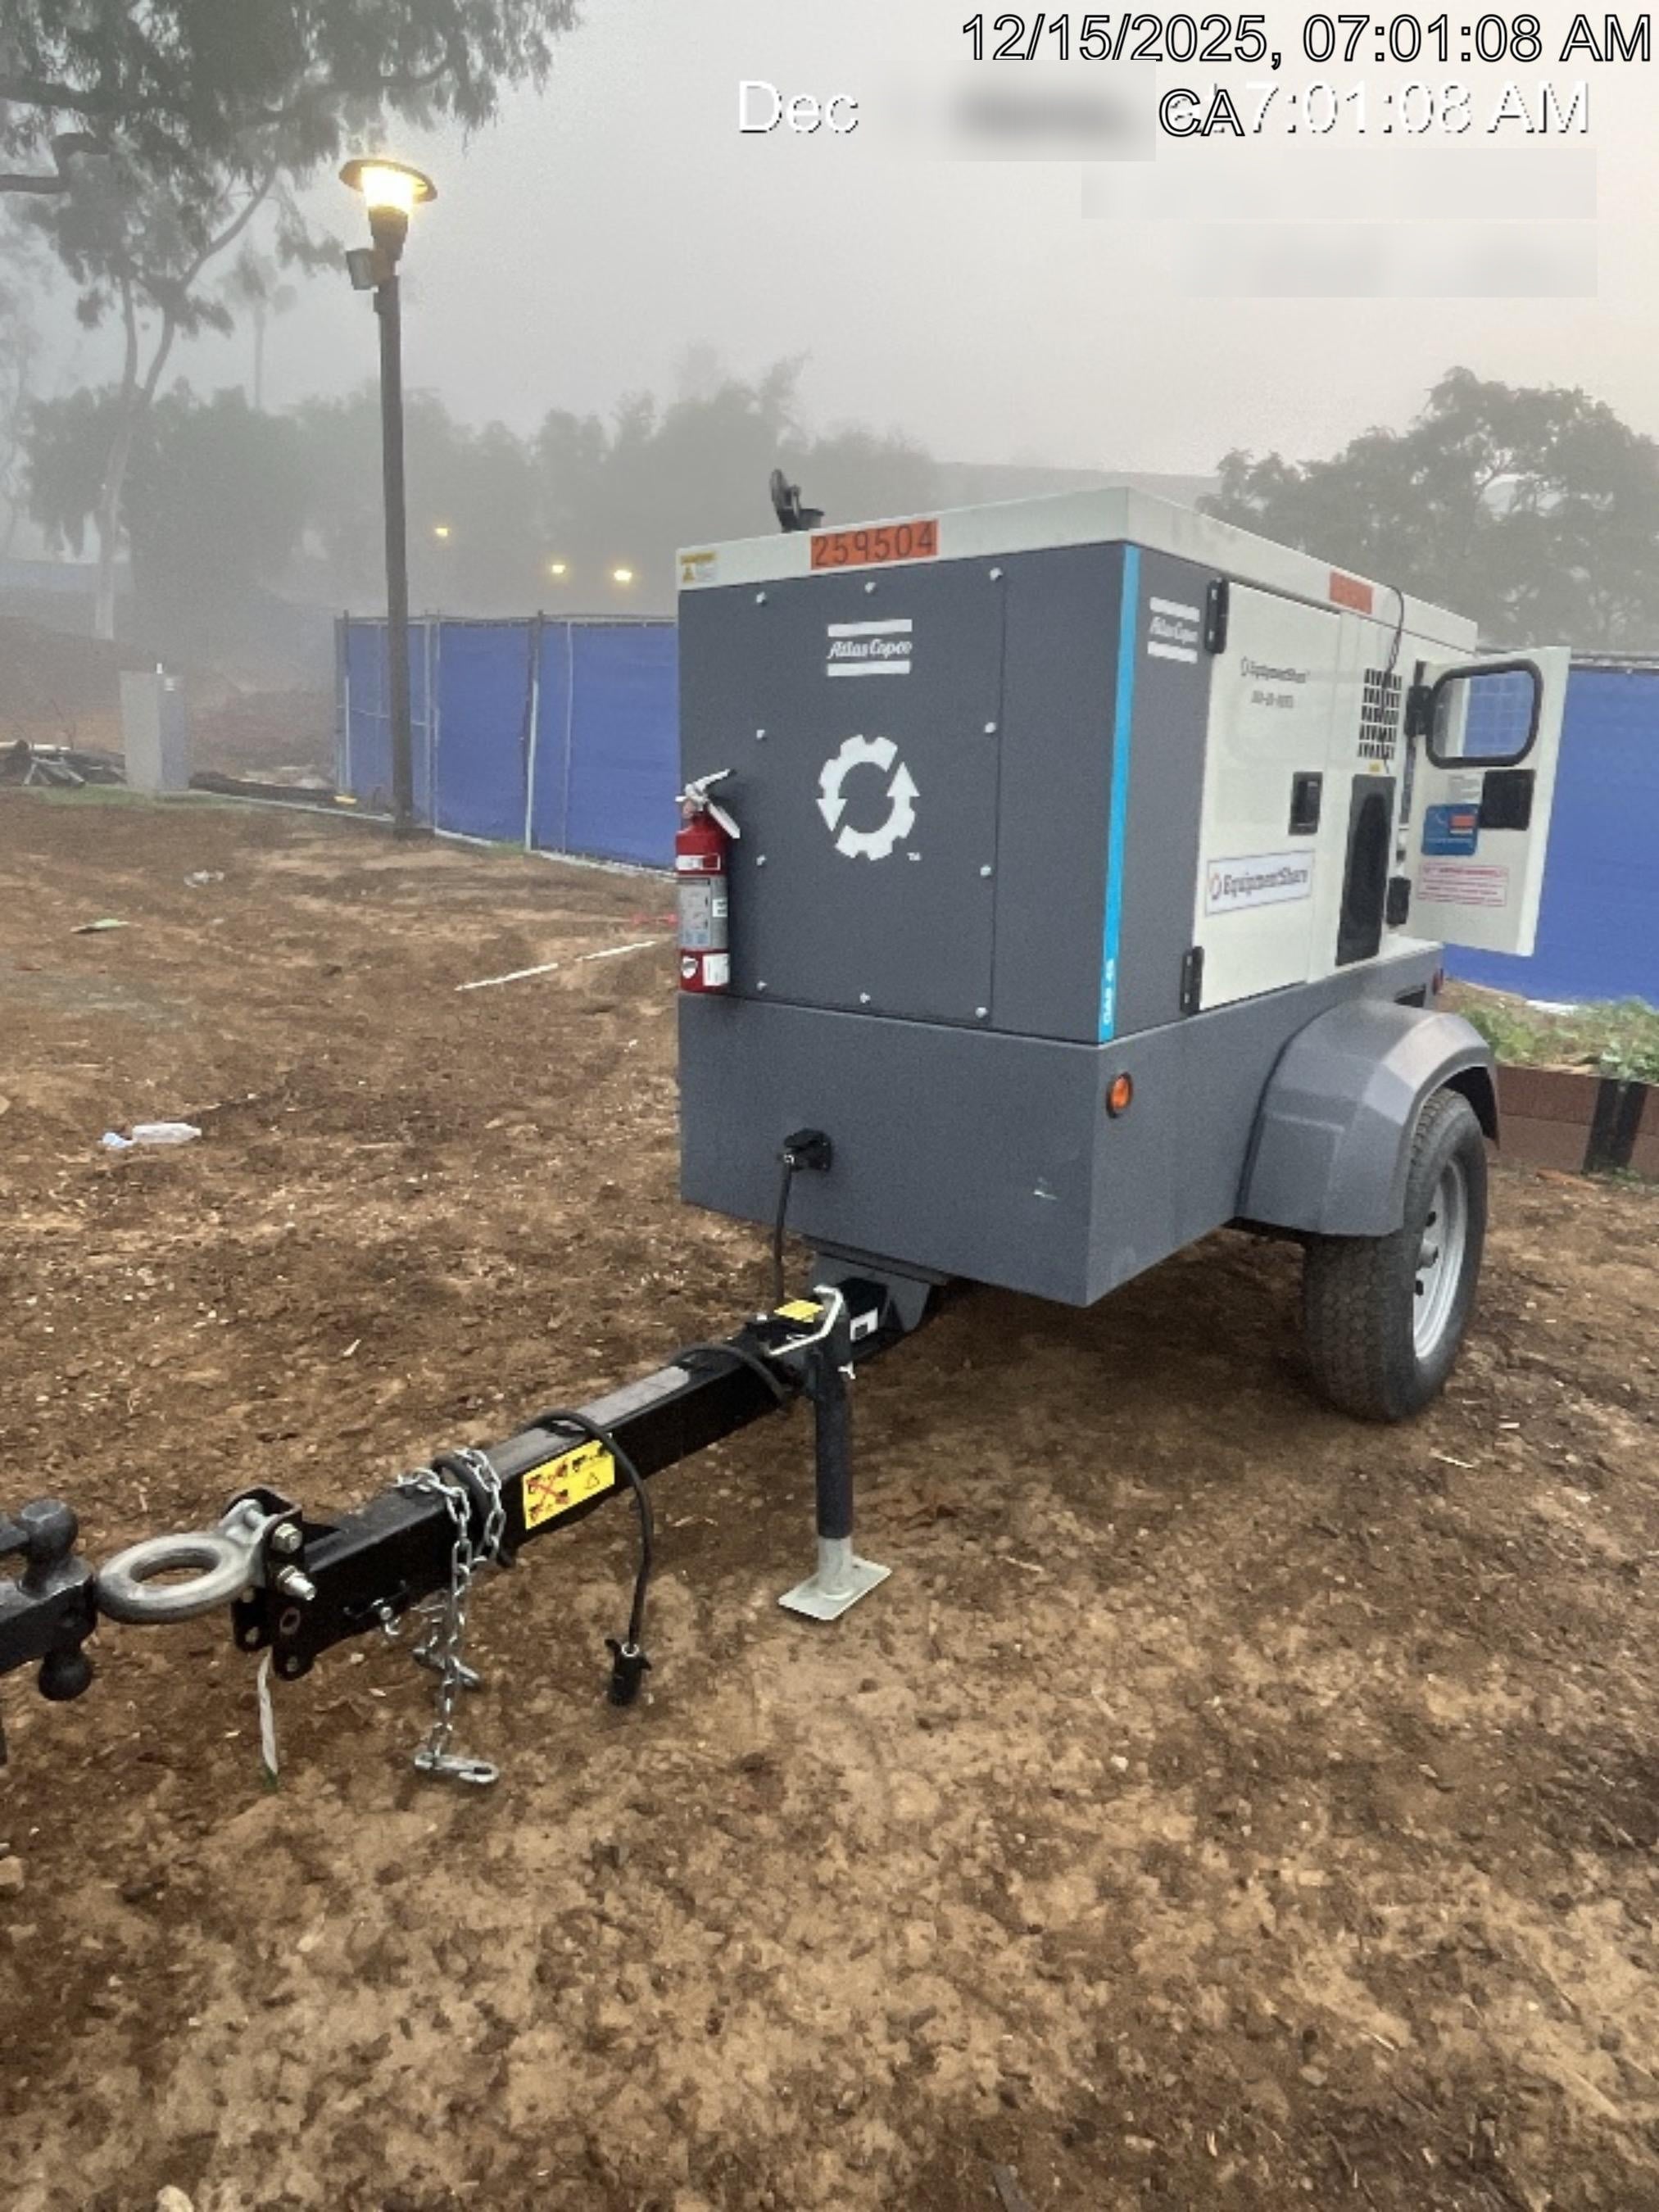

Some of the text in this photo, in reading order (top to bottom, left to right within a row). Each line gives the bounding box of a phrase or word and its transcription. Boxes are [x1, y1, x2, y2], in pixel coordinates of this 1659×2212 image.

[811, 522, 933, 566] 259504
[826, 638, 913, 660] Atlas Copco
[1223, 867, 1308, 898] EquipmentShare
